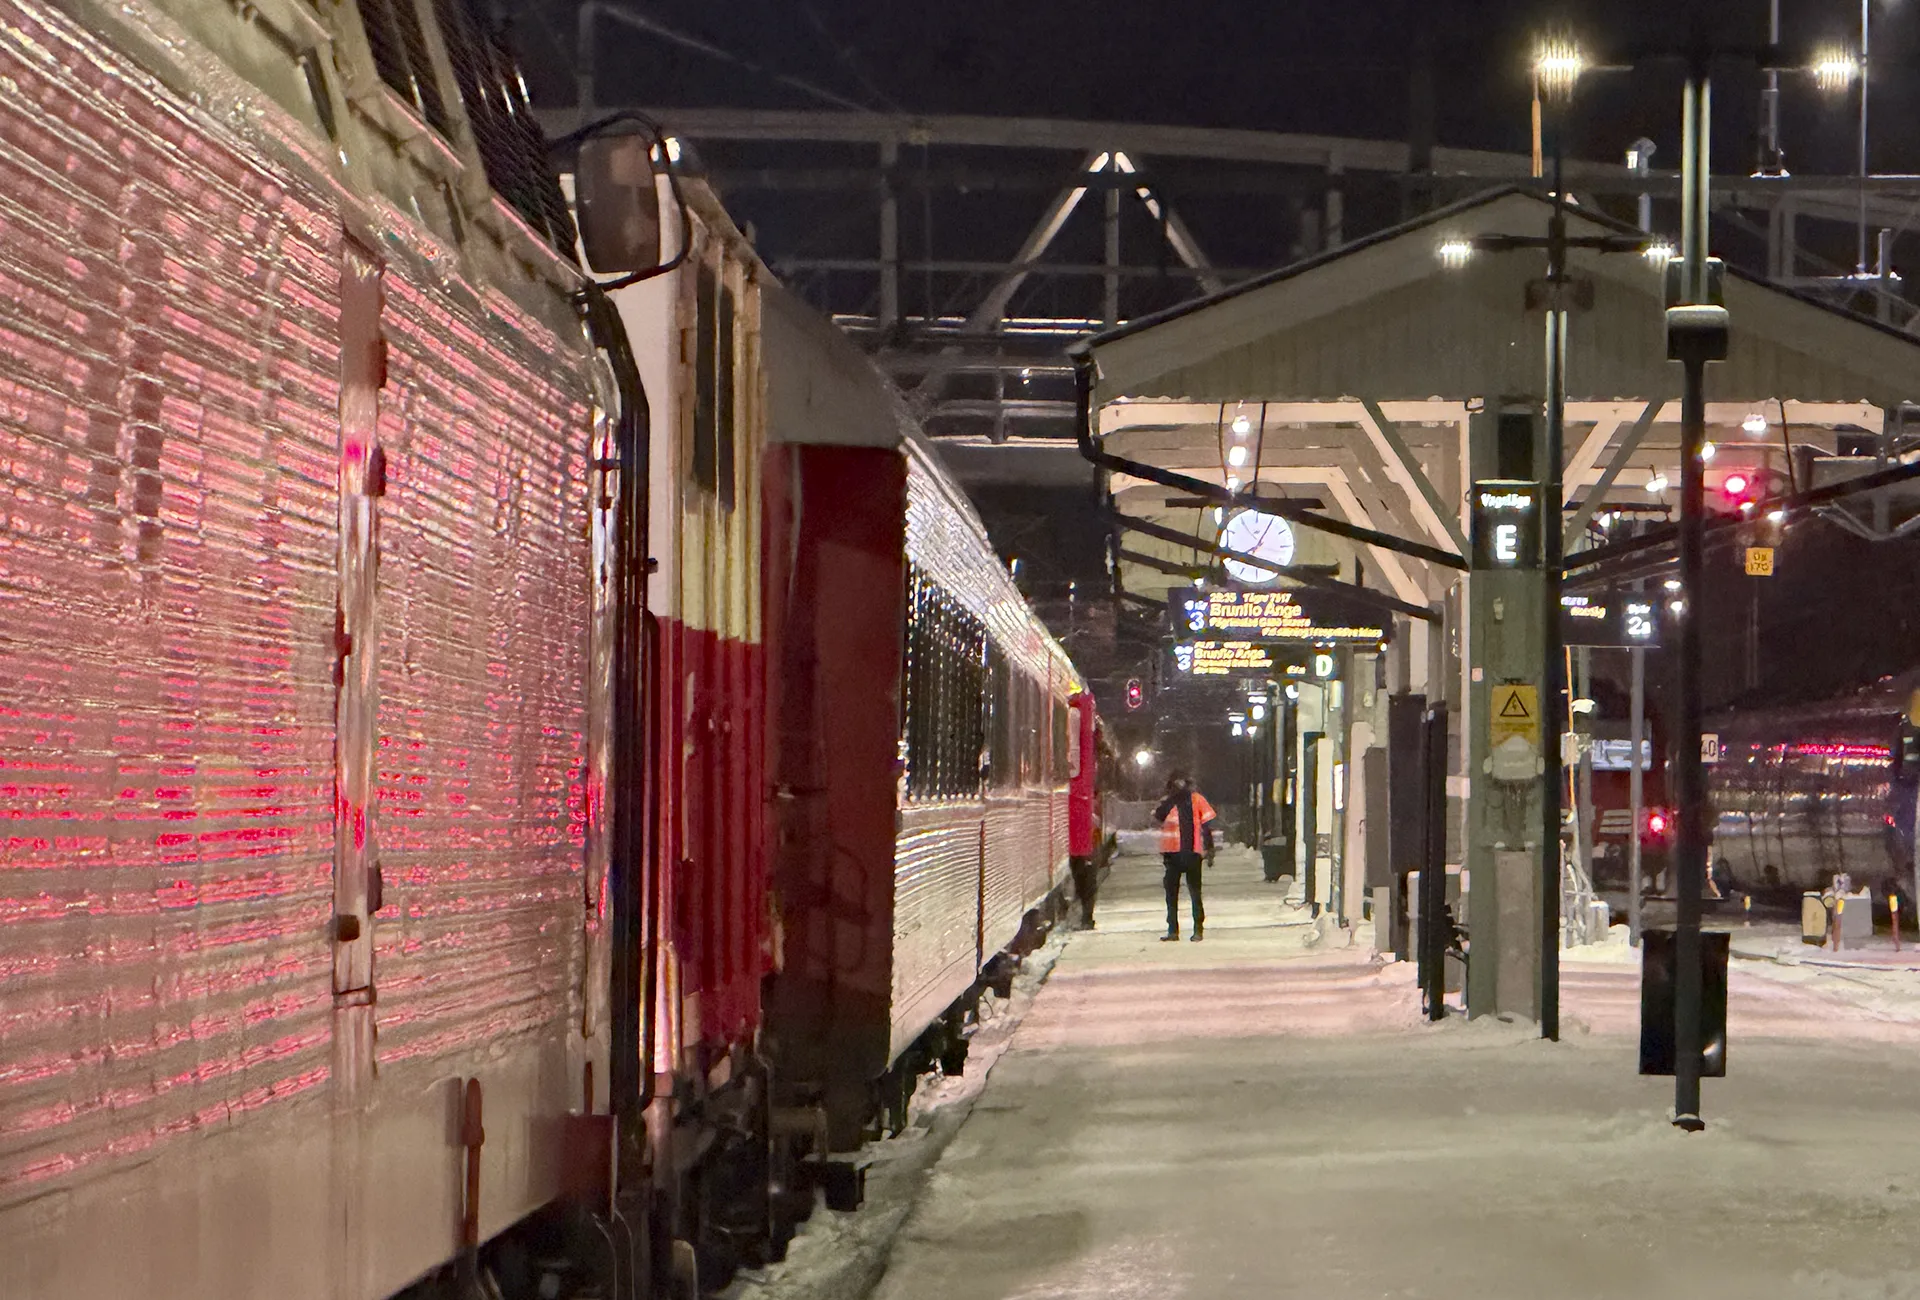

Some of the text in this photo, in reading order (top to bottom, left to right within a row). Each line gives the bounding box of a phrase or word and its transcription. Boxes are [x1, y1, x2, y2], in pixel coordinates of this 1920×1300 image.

[1497, 524, 1517, 560] E
[1189, 611, 1205, 630] 3
[1178, 654, 1191, 670] 3
[1315, 655, 1333, 676] D
